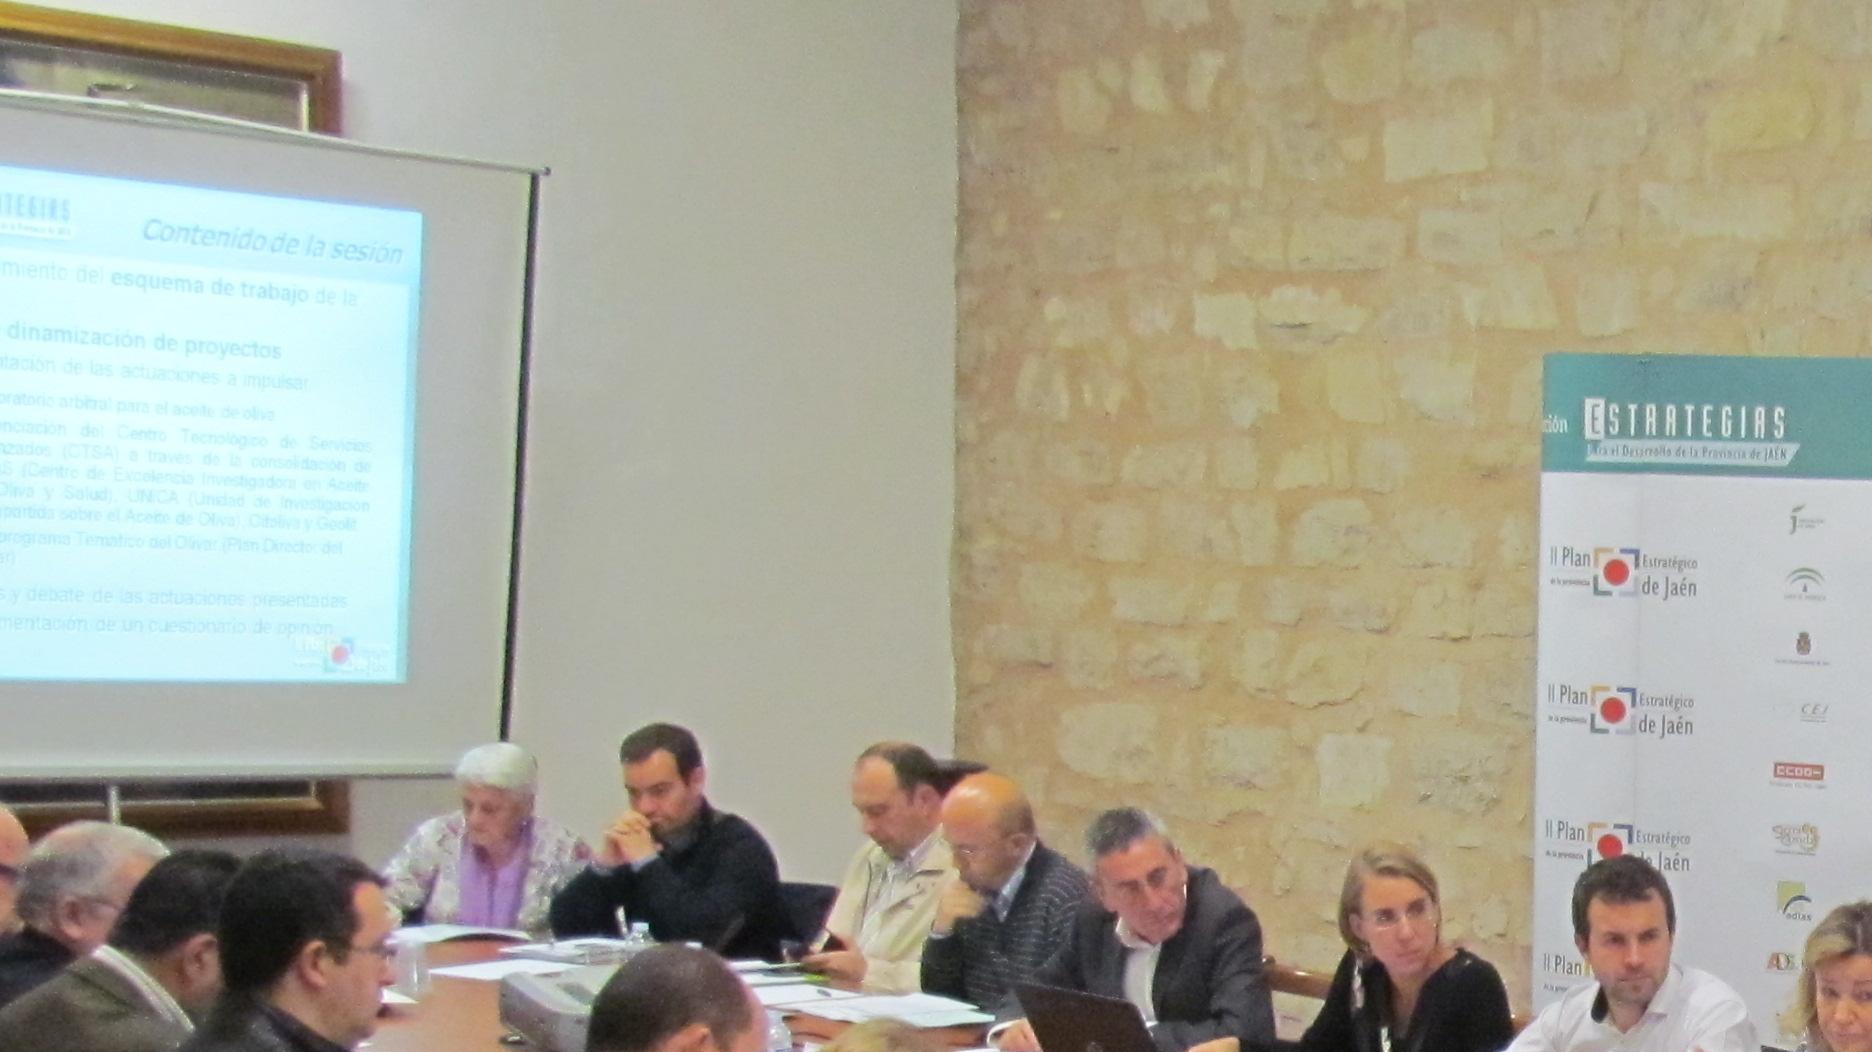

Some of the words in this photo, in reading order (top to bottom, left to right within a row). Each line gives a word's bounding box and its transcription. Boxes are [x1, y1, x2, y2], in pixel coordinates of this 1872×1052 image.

[0, 192, 71, 223] TEGIAS
[143, 217, 267, 250] Contenido
[271, 231, 299, 255] de
[305, 234, 326, 257] la
[330, 239, 404, 265] sesión
[110, 271, 205, 294] esquema
[211, 277, 235, 296] de
[240, 281, 309, 308] trabajo
[314, 289, 335, 306] de
[344, 289, 358, 307] la
[6, 320, 146, 348] dinamización
[153, 331, 178, 350] de
[185, 338, 282, 360] proyectos
[63, 359, 82, 375] de
[90, 359, 114, 378] las
[120, 363, 220, 385] actuaciones
[227, 373, 237, 386] a
[243, 371, 309, 391] impulsar
[116, 400, 150, 417] para
[155, 401, 168, 415] el
[221, 404, 241, 419] de
[242, 404, 276, 422] oliva
[1588, 401, 1786, 440] ESTRATEGIAS
[280, 434, 298, 449] de
[1562, 546, 1591, 567] Plan
[1642, 554, 1699, 573] Estratégico
[92, 587, 113, 603] de
[119, 587, 143, 604] las
[1642, 575, 1660, 596] de
[1663, 575, 1698, 601] Jaén
[94, 616, 116, 633] de
[121, 618, 144, 633] un
[253, 617, 272, 635] de
[1560, 684, 1588, 705] Plan
[1639, 692, 1695, 712] Estratégico
[1639, 714, 1657, 734] de
[1659, 714, 1693, 740] Jaén
[1557, 820, 1585, 841] Plan
[1636, 829, 1691, 848] Estratégico
[1659, 850, 1691, 871] Jaén
[1554, 954, 1582, 976] Plan
